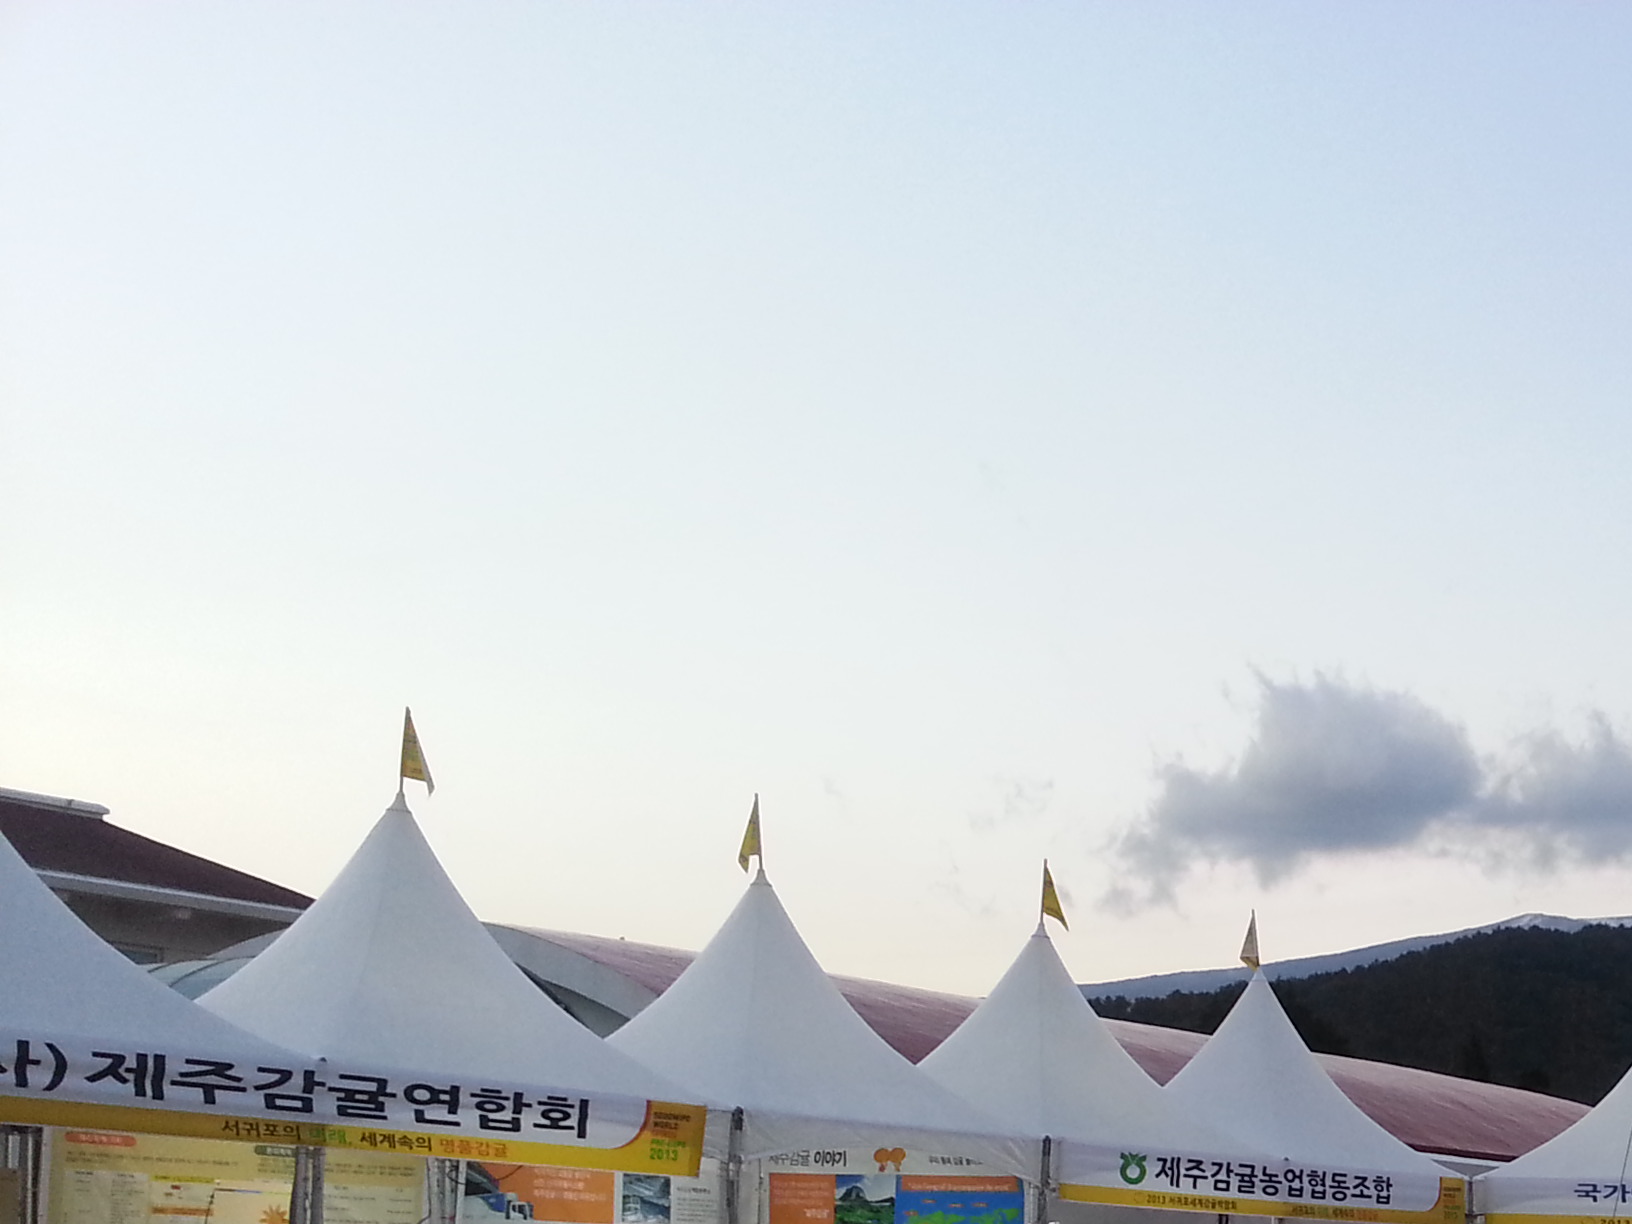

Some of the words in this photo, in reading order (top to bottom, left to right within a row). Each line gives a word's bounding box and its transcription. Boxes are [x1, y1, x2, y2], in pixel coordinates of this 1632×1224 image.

[84, 1050, 589, 1139] 제주감귤연합회
[222, 1119, 301, 1141] 서귀포의
[360, 1132, 433, 1152] 세계속의
[650, 1147, 679, 1161] 2013
[1155, 1156, 1393, 1205] 제주감귤농업협동조합
